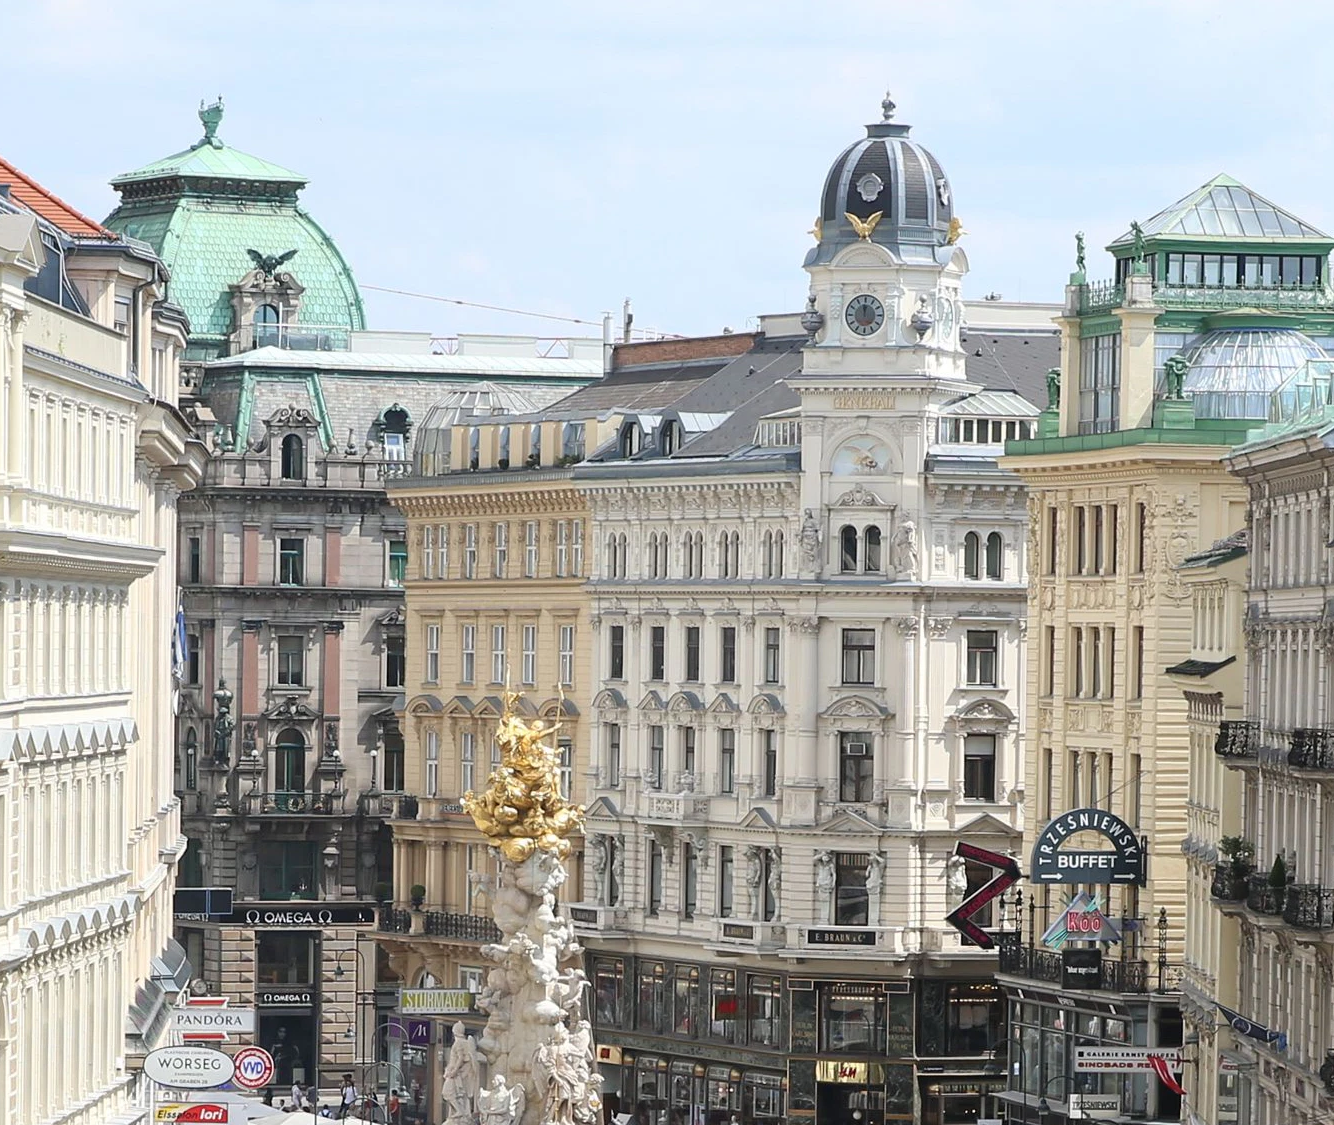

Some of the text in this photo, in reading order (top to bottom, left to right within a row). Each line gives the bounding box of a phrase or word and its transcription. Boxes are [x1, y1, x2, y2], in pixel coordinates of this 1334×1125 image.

[1058, 855, 1118, 869] BUFFET
[264, 912, 314, 923] OMEGA
[407, 992, 465, 1008] STURMAYR
[177, 1012, 243, 1026] PANDORA
[158, 1057, 221, 1070] WORSEG
[157, 1109, 198, 1119] Eissalon
